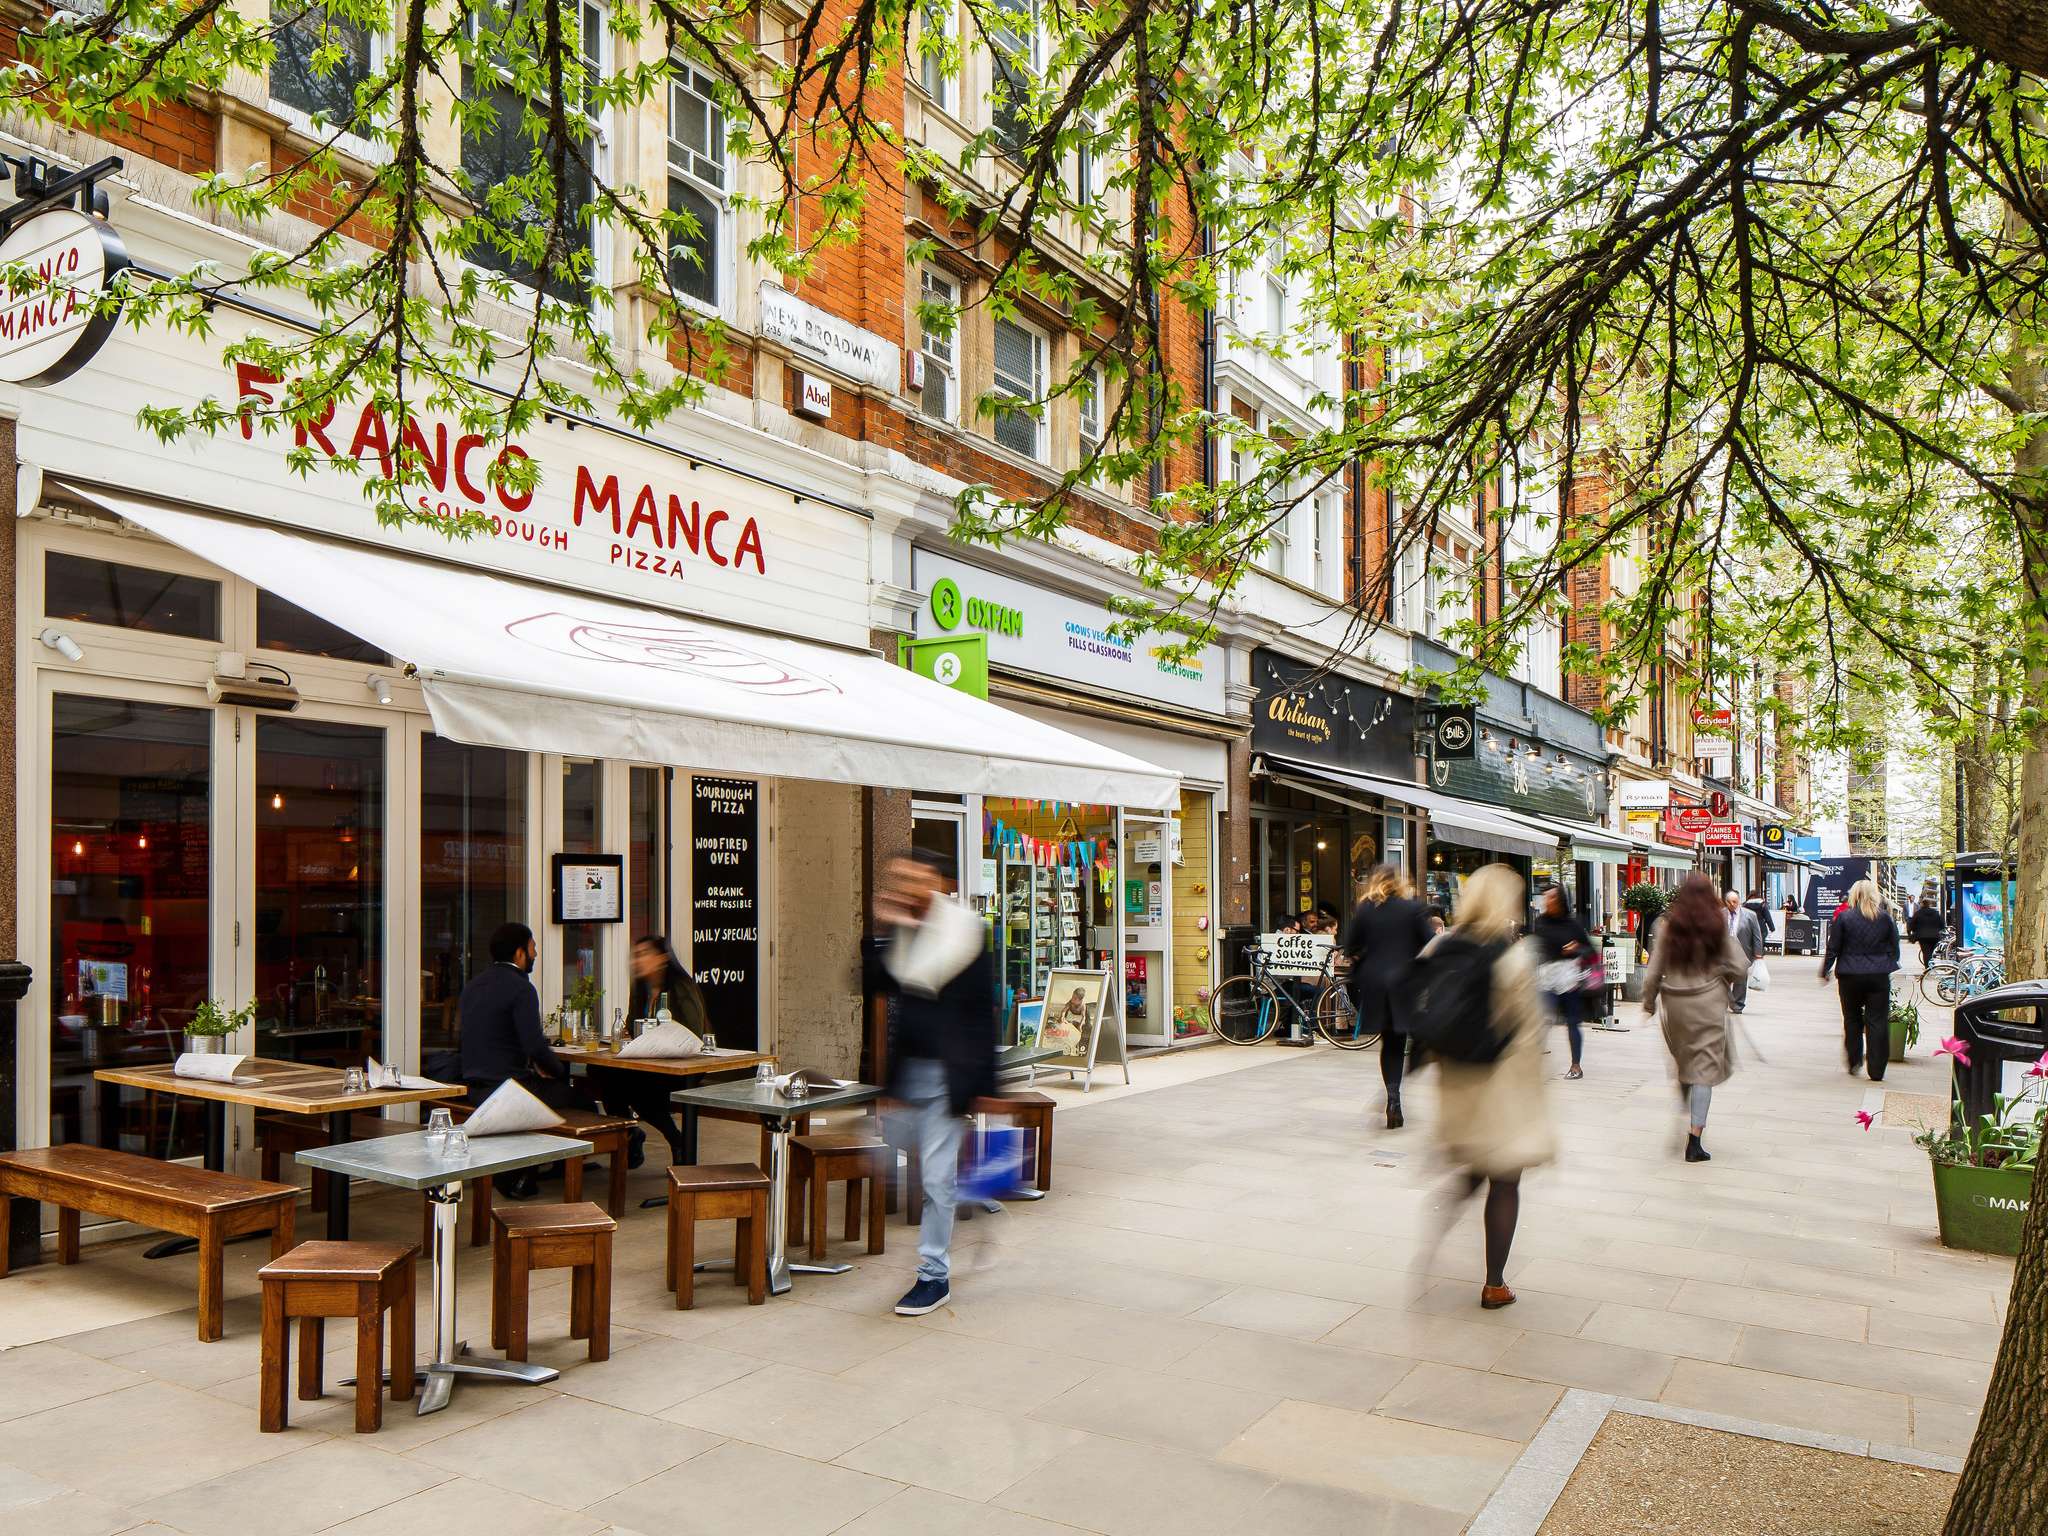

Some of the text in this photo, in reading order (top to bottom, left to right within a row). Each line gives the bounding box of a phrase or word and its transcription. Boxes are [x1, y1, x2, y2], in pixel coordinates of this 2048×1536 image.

[767, 305, 880, 368] NEW BROADWAY
[805, 384, 831, 408] Abel
[573, 465, 766, 576] MANCA
[610, 543, 684, 580] PIZZA
[967, 596, 1024, 639] OXFAM
[1065, 621, 1090, 639] GROWS
[1068, 636, 1087, 651] FILLS
[1087, 642, 1132, 663] CLASSROOMS
[1157, 661, 1203, 682] FIGHTS POVERTY
[1268, 696, 1326, 730] Artisan
[1445, 725, 1465, 739] Bill's
[696, 784, 753, 801] SOURDOUGH
[711, 800, 745, 815] PIZZA
[695, 837, 748, 852] WOOD FIRED
[710, 852, 739, 865] OVEN
[707, 886, 744, 897] ORGANIC
[694, 899, 753, 909] WHERE POSSIBLE
[693, 927, 758, 943] DAILY SPECIALS
[694, 969, 745, 984] WE YOU
[1989, 1196, 2029, 1211] MAK
